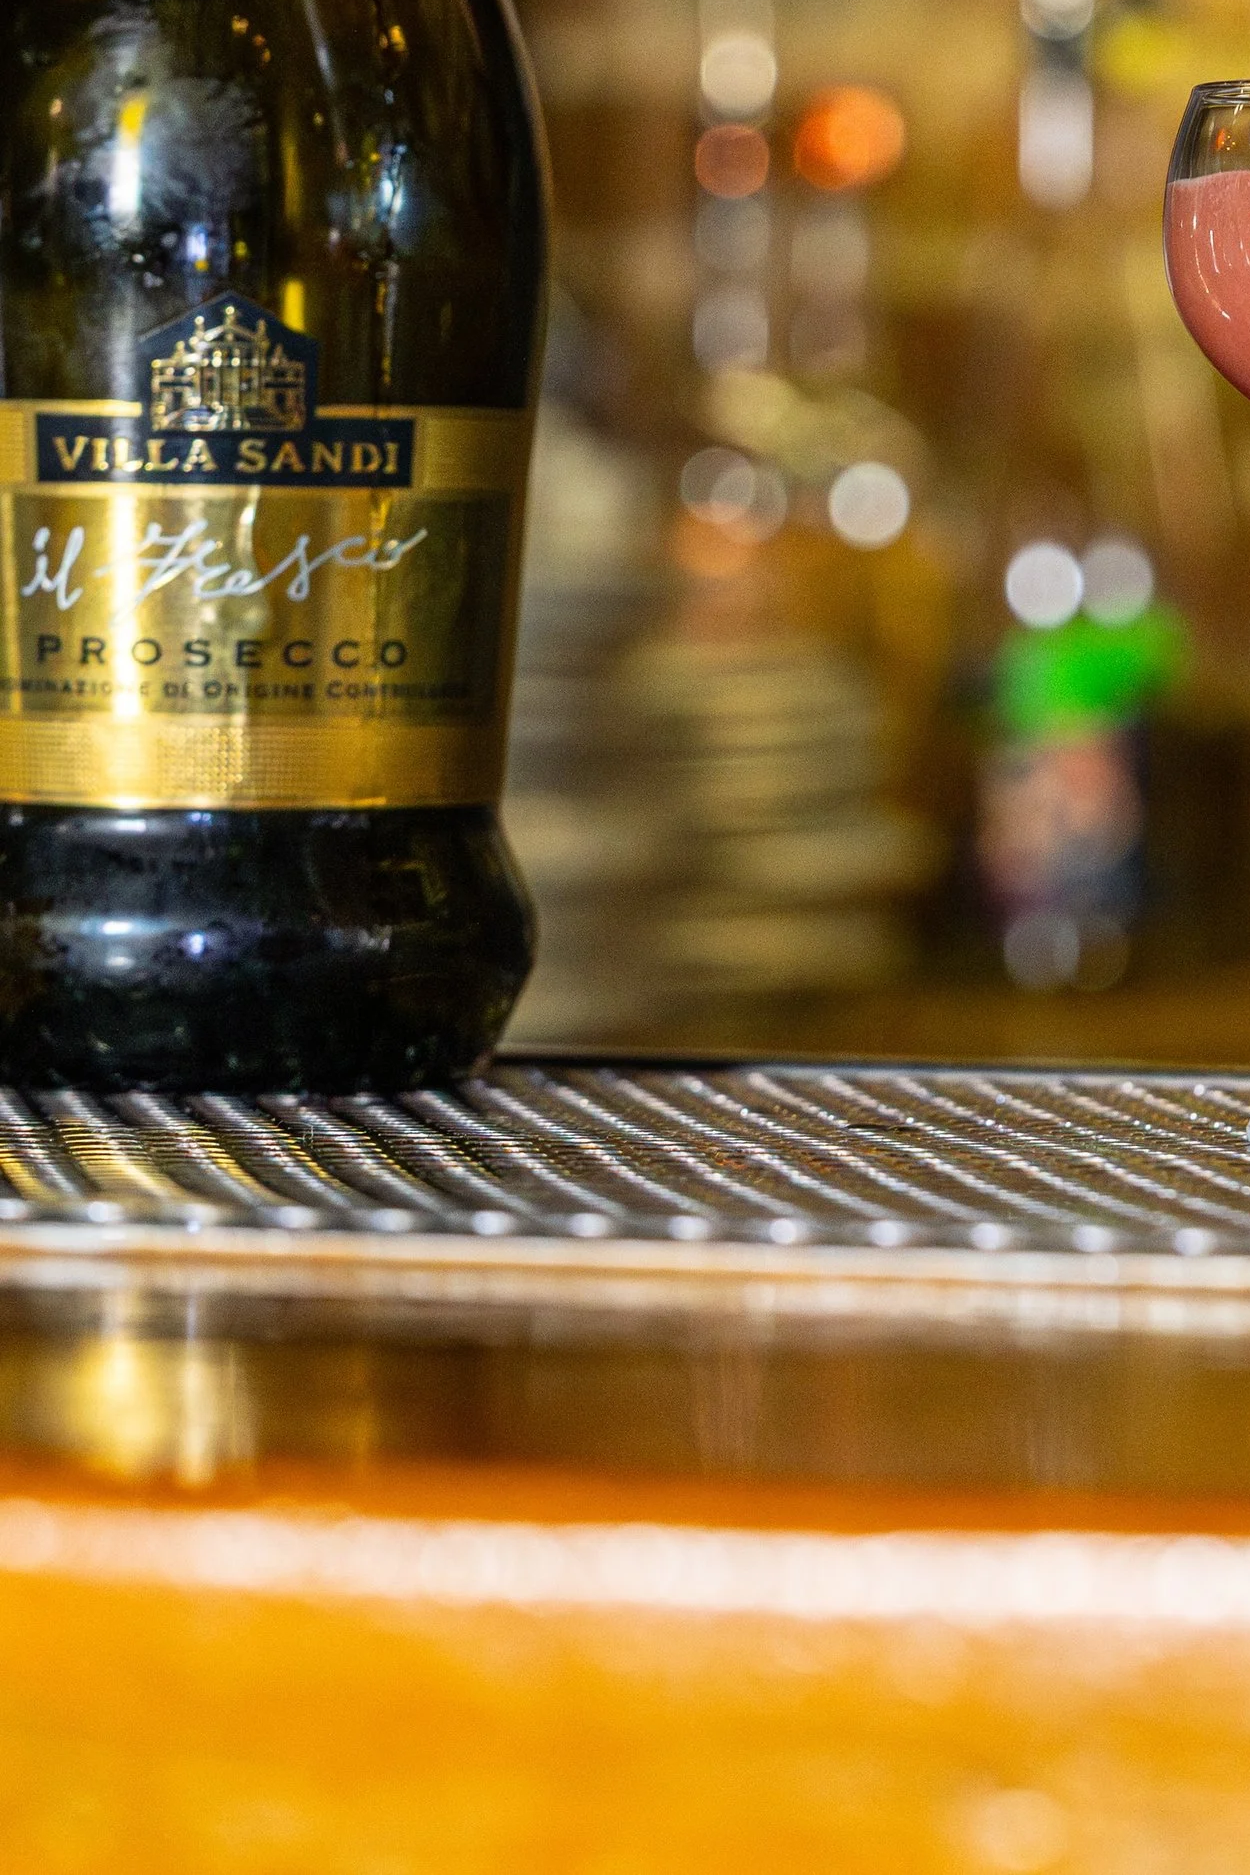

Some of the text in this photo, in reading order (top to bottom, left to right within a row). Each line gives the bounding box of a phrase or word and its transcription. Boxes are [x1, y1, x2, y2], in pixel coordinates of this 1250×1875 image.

[53, 435, 399, 474] VILLA SANDI
[36, 634, 408, 669] PROSECCO
[204, 680, 315, 699] ORGINE
